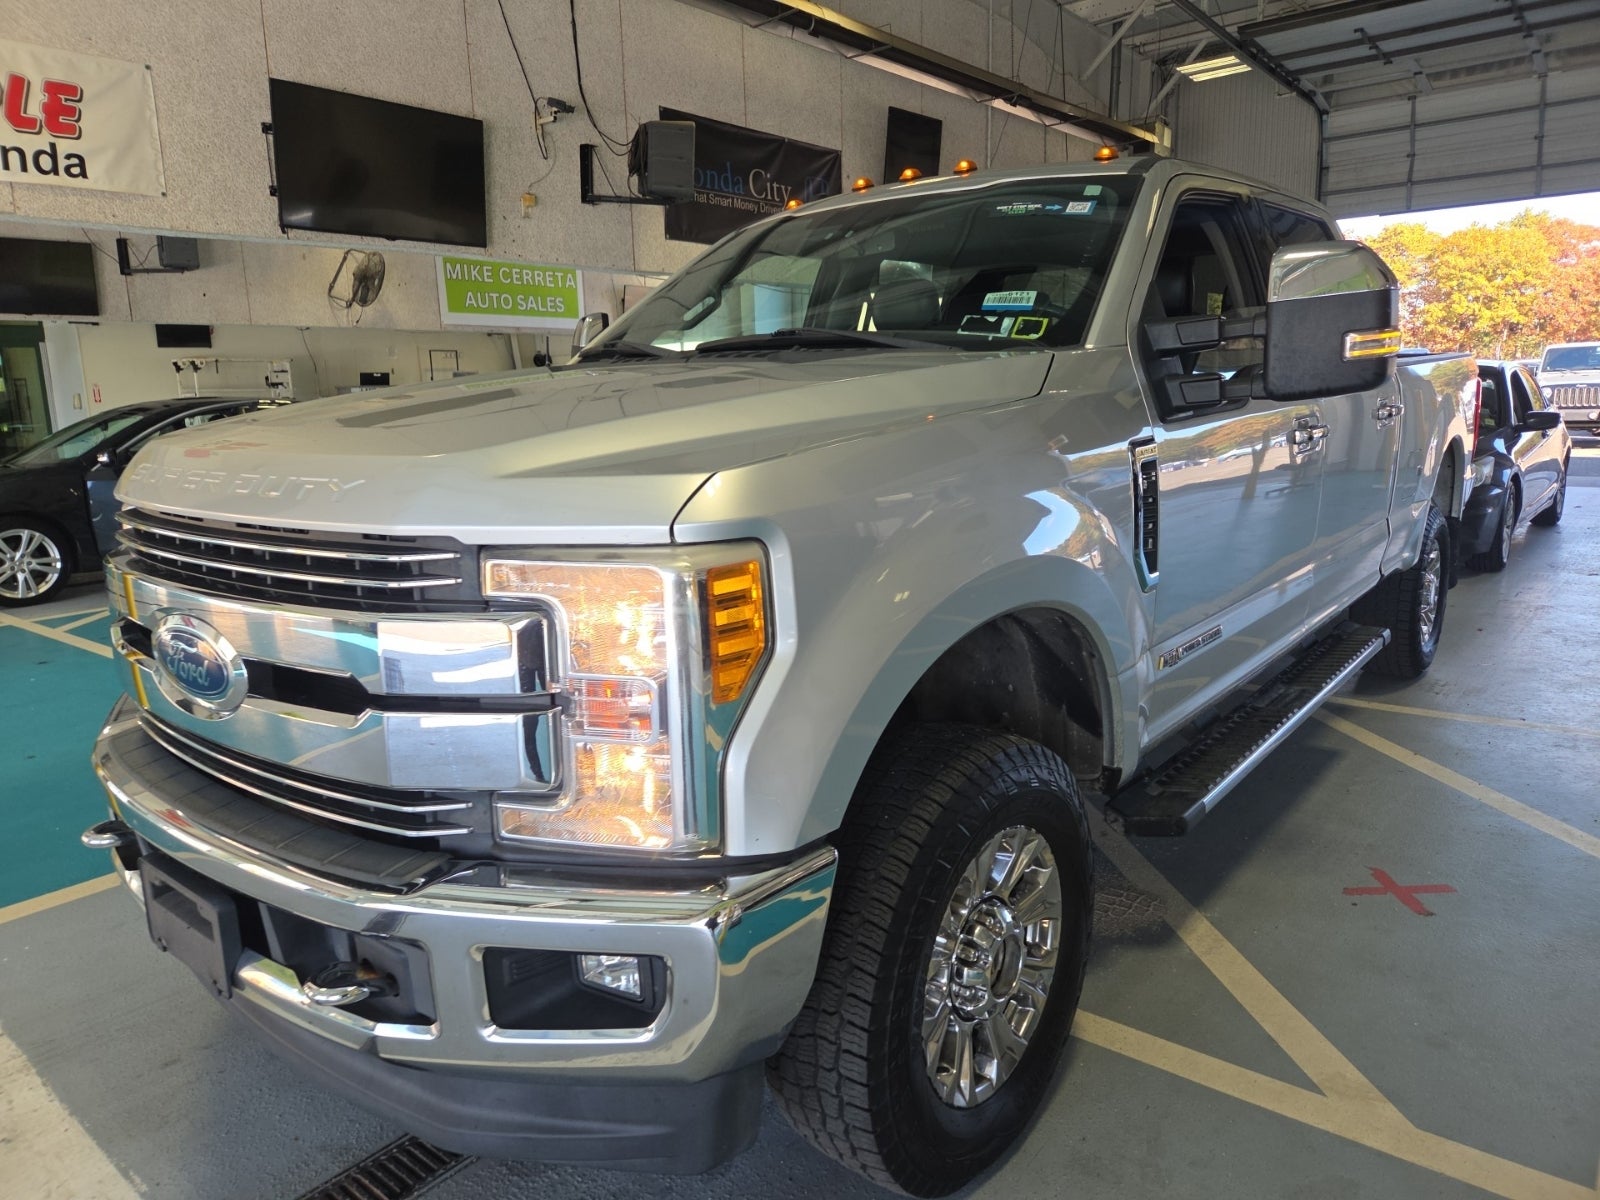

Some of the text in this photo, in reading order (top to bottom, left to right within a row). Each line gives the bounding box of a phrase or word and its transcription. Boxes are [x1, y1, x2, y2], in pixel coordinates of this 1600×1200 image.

[0, 71, 83, 140] LE
[0, 142, 89, 179] nda
[695, 161, 744, 194] onda
[749, 168, 792, 211] City
[695, 191, 707, 204] hat
[708, 193, 732, 208] Smart
[734, 198, 759, 214] Money
[445, 262, 576, 289] MIKE CERRETA
[465, 291, 565, 313] AUTO SALES
[131, 463, 367, 502] SUPER DUTY
[166, 640, 211, 686] Ford
